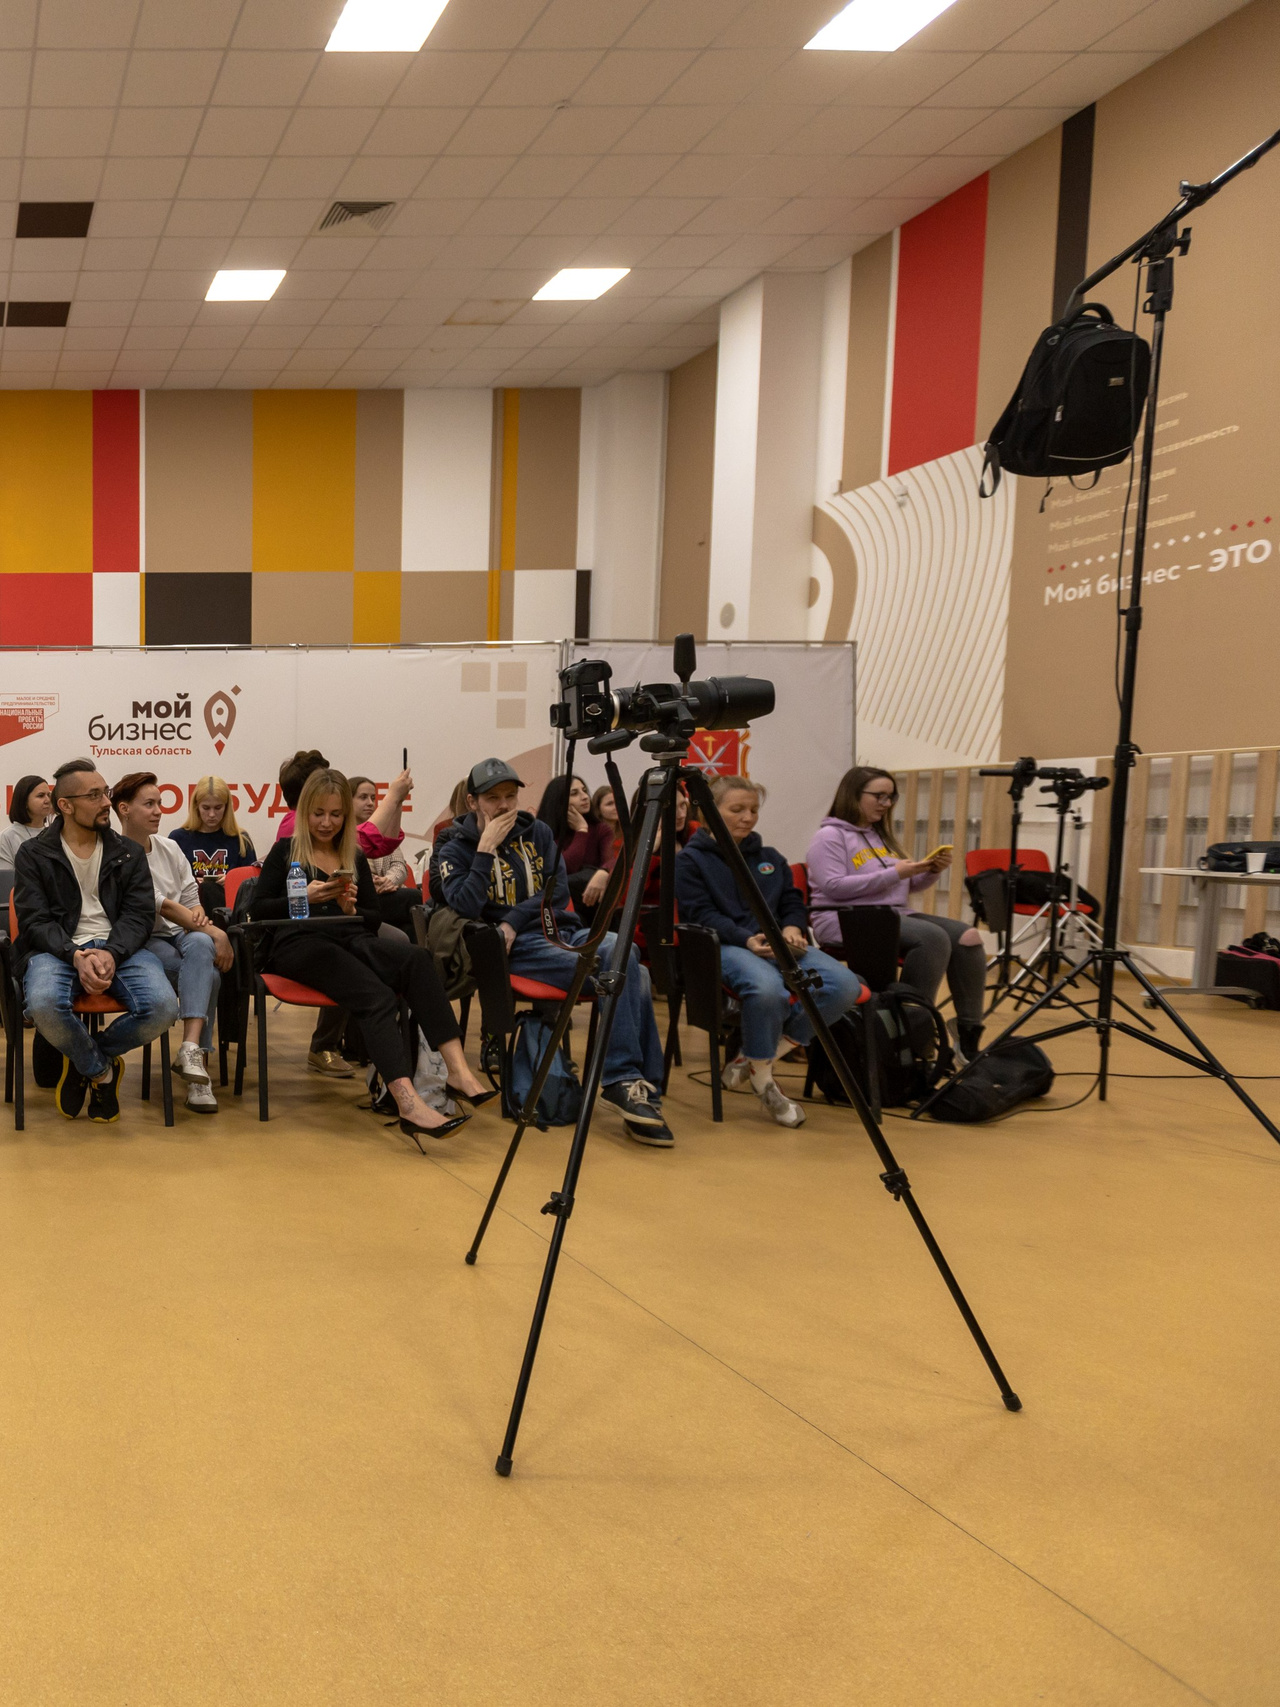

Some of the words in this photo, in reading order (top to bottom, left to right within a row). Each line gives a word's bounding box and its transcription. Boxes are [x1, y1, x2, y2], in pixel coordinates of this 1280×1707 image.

[1044, 578, 1092, 606] Мой
[1207, 538, 1272, 573] ЭТО
[132, 692, 191, 719] мой
[88, 714, 192, 741] бизнес
[89, 745, 142, 758] Тульская
[145, 745, 192, 756] область
[543, 907, 553, 928] EOS
[546, 927, 554, 935] R
